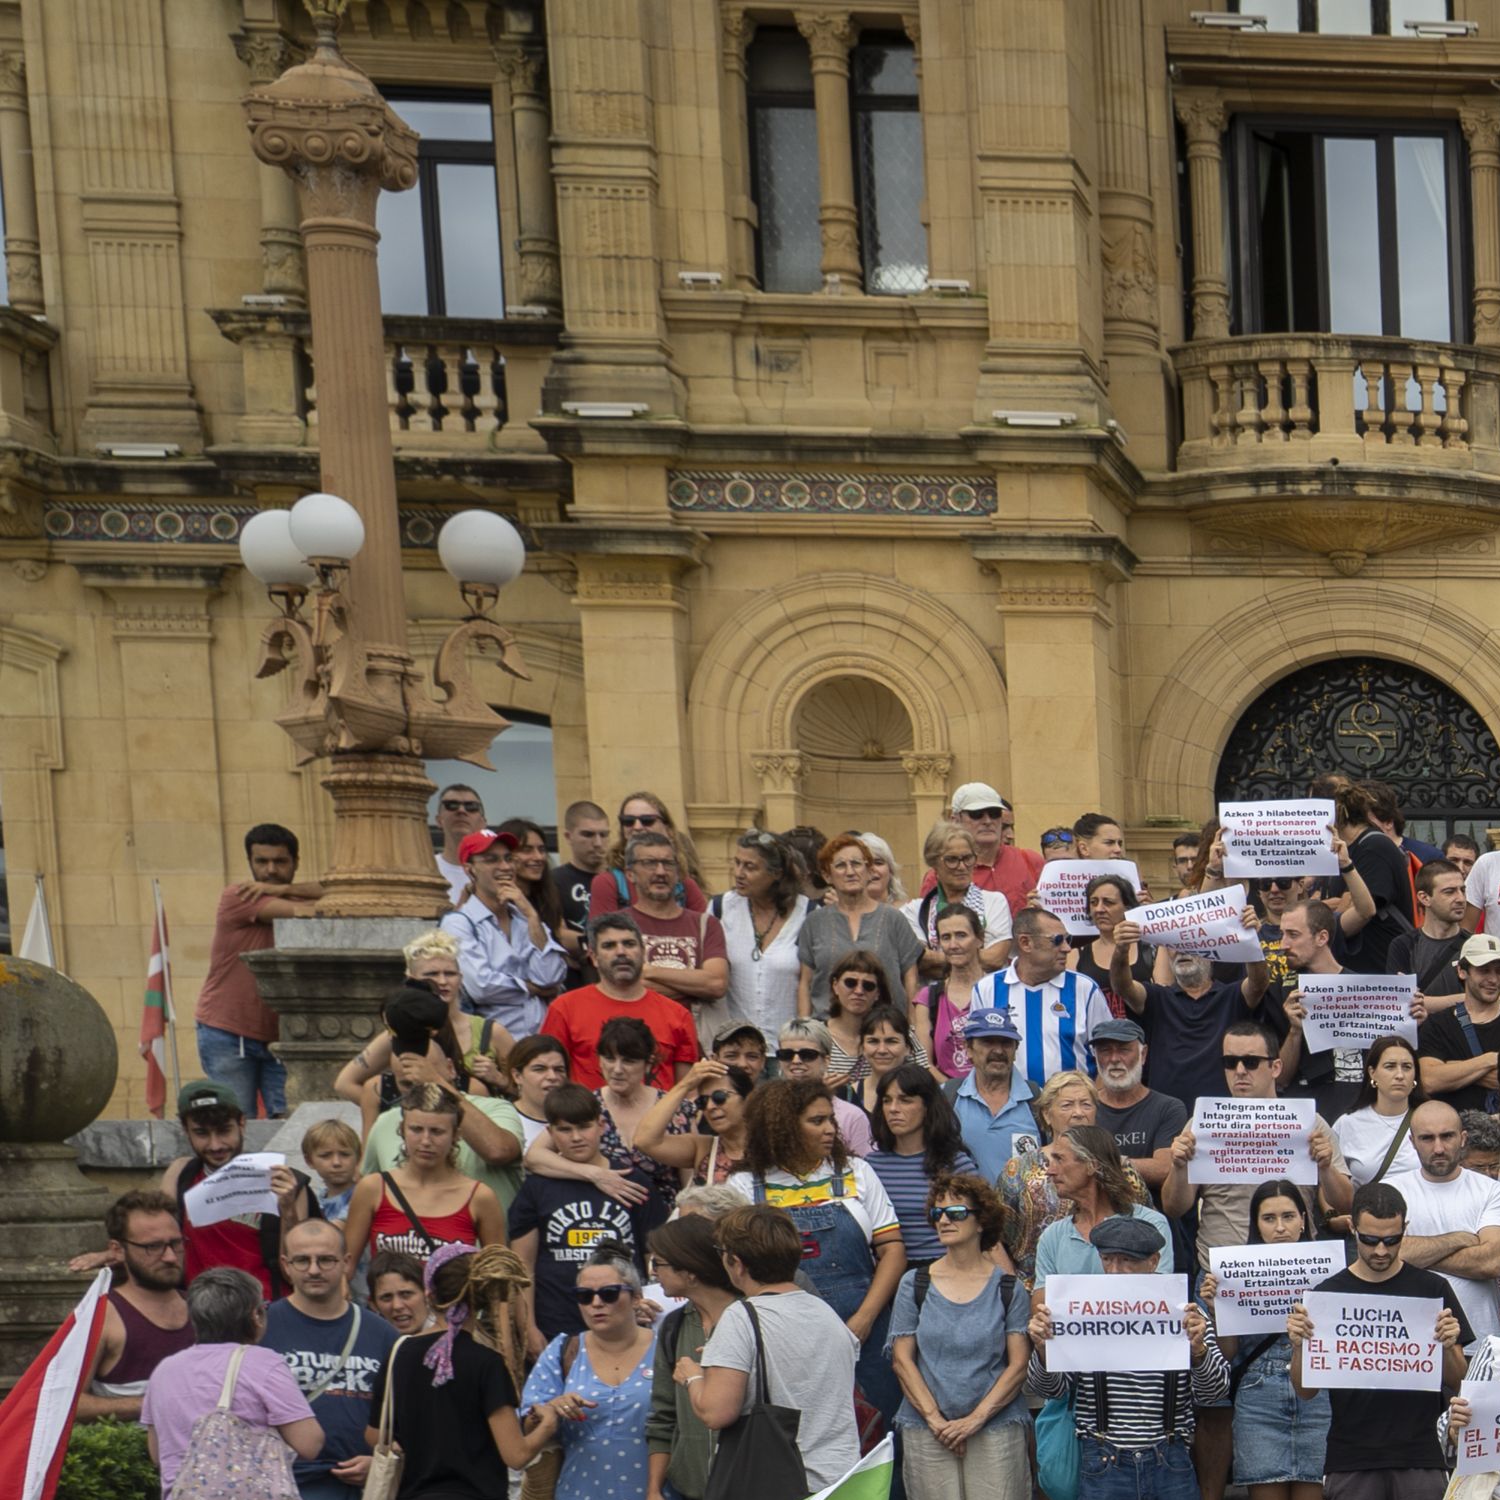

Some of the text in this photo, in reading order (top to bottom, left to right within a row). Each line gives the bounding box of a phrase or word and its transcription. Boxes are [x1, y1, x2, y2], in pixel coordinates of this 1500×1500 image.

[1224, 810, 1254, 818] Azken
[1266, 809, 1329, 817] hilabeteetan
[1256, 819, 1317, 828] pertsonaren
[1231, 838, 1325, 847] ditu Udaltzaingoak
[1260, 848, 1317, 856] Ertzaintzak
[1255, 858, 1305, 866] Donostian
[1145, 895, 1226, 920] DONOSTIAN
[1143, 906, 1237, 936] ARRAZAKERIA
[1180, 927, 1207, 940] ETA
[1347, 985, 1411, 993] hilabeteetan
[1336, 995, 1398, 1003] pertsonaren
[1310, 1011, 1405, 1022] ditu Udaltzaingoak
[1339, 1021, 1396, 1031] Ertzaintzak
[1215, 1102, 1265, 1112] Telegram
[1203, 1112, 1251, 1121] Intagram
[1254, 1123, 1301, 1132] pertsona
[1114, 1131, 1148, 1147] SKE!
[1225, 1140, 1278, 1148] aurpegiak
[1209, 1148, 1274, 1157] argitaratzen
[1219, 1165, 1286, 1175] deiak eginez
[547, 1201, 593, 1243] TOKYO
[1220, 1257, 1331, 1268] Azken hilabeteetan
[1223, 1268, 1307, 1279] Udaltzaingoak
[1244, 1277, 1310, 1288] Ertzaintzak
[1221, 1290, 1235, 1298] 85
[1239, 1288, 1290, 1299] pertsona
[1068, 1300, 1170, 1315] FAXISMOA
[1237, 1299, 1260, 1307] ditu
[1342, 1307, 1403, 1322] LUCHA
[1052, 1320, 1182, 1336] BORROKATU
[1335, 1324, 1409, 1339] CONTRA
[1308, 1339, 1329, 1353] EL
[1336, 1340, 1420, 1356] RACISMO
[1310, 1356, 1434, 1373] EL FASCISMO
[1464, 1428, 1486, 1443] EL
[1466, 1444, 1488, 1458] EL
